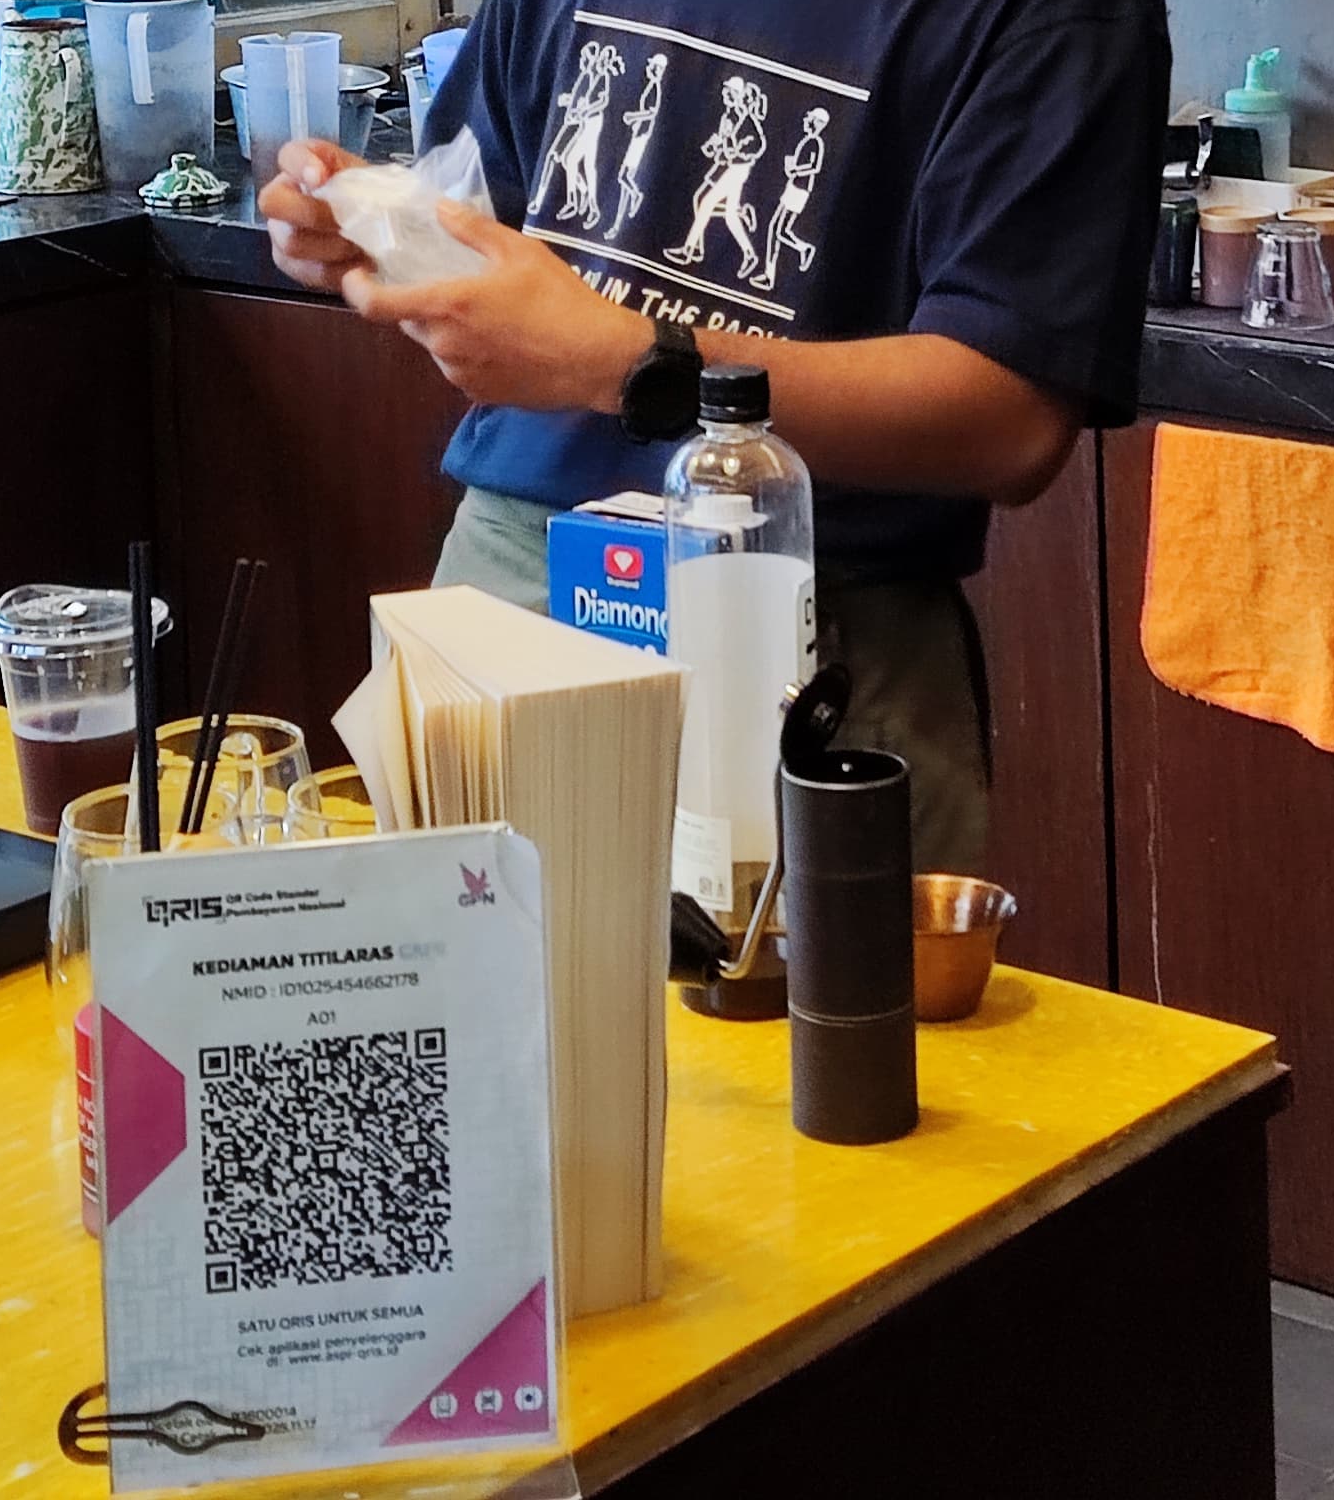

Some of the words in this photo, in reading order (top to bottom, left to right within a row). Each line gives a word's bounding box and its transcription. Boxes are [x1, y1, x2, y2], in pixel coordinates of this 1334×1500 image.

[146, 896, 223, 927] QRIS
[192, 953, 294, 977] KEDIAMAN
[298, 945, 395, 967] TITILARAS
[221, 985, 267, 1001] NMID
[237, 1318, 276, 1334] SATU
[317, 1309, 369, 1327] UNTUK
[371, 1304, 425, 1320] SEMUA
[237, 1344, 264, 1358] Cek
